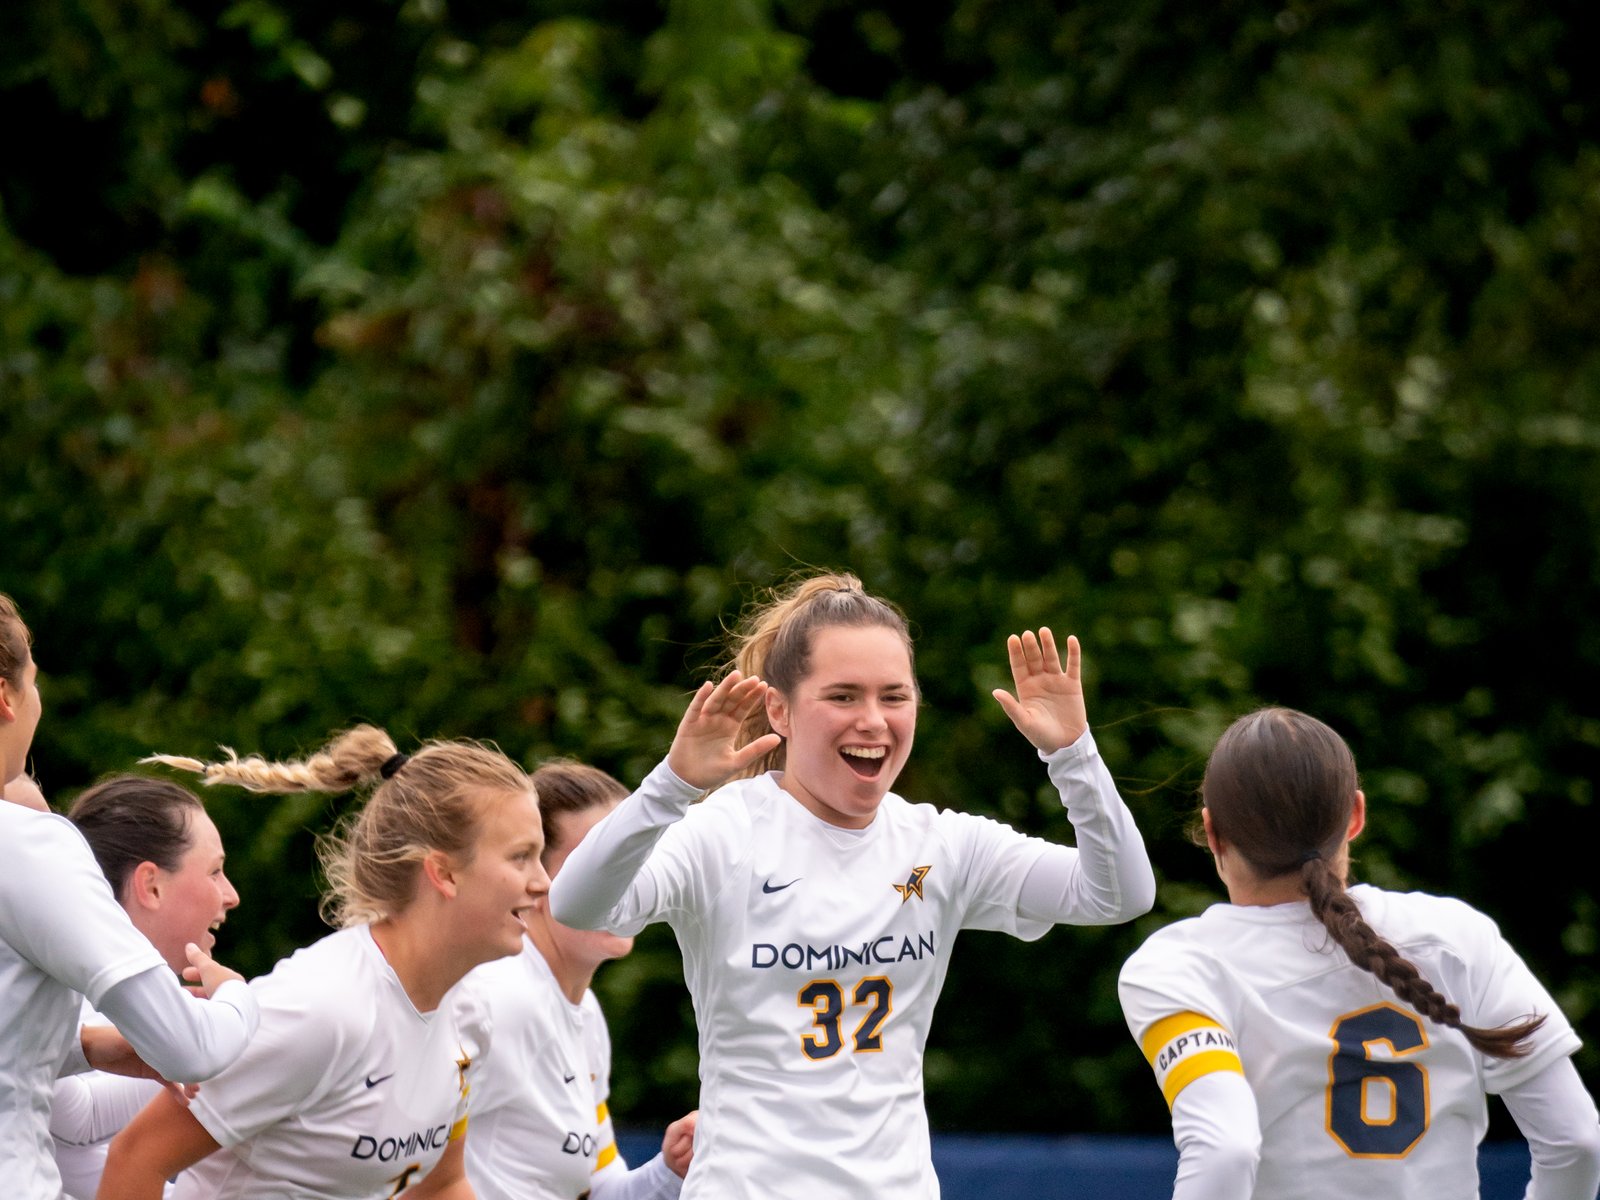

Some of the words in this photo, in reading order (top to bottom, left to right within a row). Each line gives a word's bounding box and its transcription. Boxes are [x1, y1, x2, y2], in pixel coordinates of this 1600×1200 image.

[751, 930, 935, 971] DOMINICAN
[797, 975, 894, 1062] 32
[1325, 1001, 1431, 1159] 6
